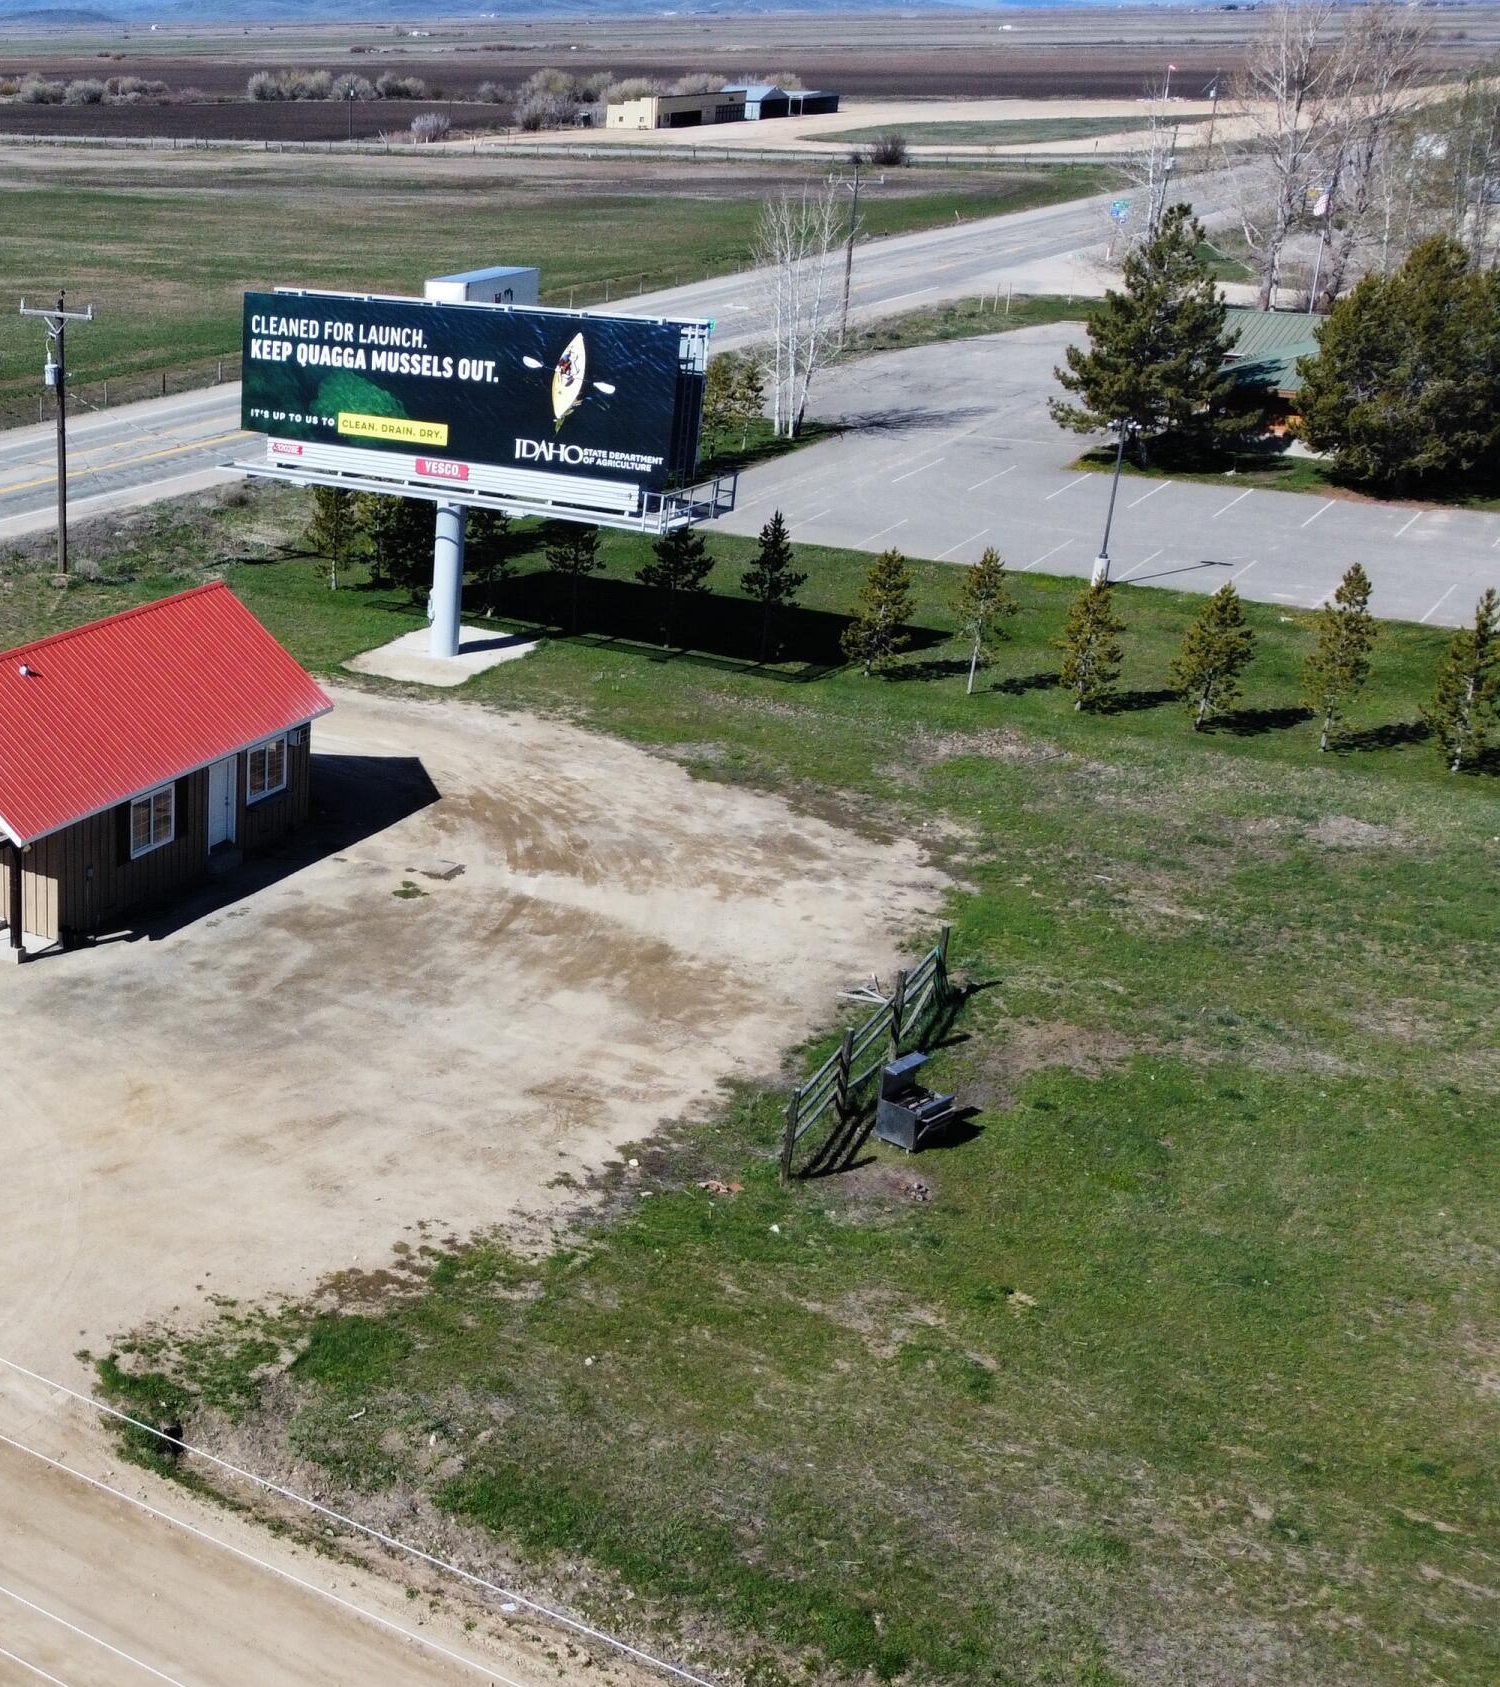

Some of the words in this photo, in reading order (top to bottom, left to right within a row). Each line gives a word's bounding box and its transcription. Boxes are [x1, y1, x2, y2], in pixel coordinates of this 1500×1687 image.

[251, 314, 319, 339] CLEANED
[324, 321, 354, 342] FOR
[359, 325, 428, 349] LAUNCH.
[251, 338, 293, 362] KEEP
[296, 343, 367, 370] QUAGGA
[371, 350, 453, 378] MUSSELS
[457, 358, 499, 383] OUT.
[250, 408, 270, 419] IT'S
[272, 410, 286, 421] UP
[288, 412, 303, 423] TO
[305, 414, 319, 425] US
[321, 416, 336, 427] TO
[341, 419, 378, 432] CLEAN.
[381, 424, 416, 437] DRAIN.
[419, 428, 443, 440] DRY.
[514, 438, 584, 465] IDAHO
[582, 456, 594, 465] OF
[595, 458, 652, 473] AGRICULTURE
[583, 448, 608, 459] STATE
[608, 451, 664, 465] DEPARTMENT
